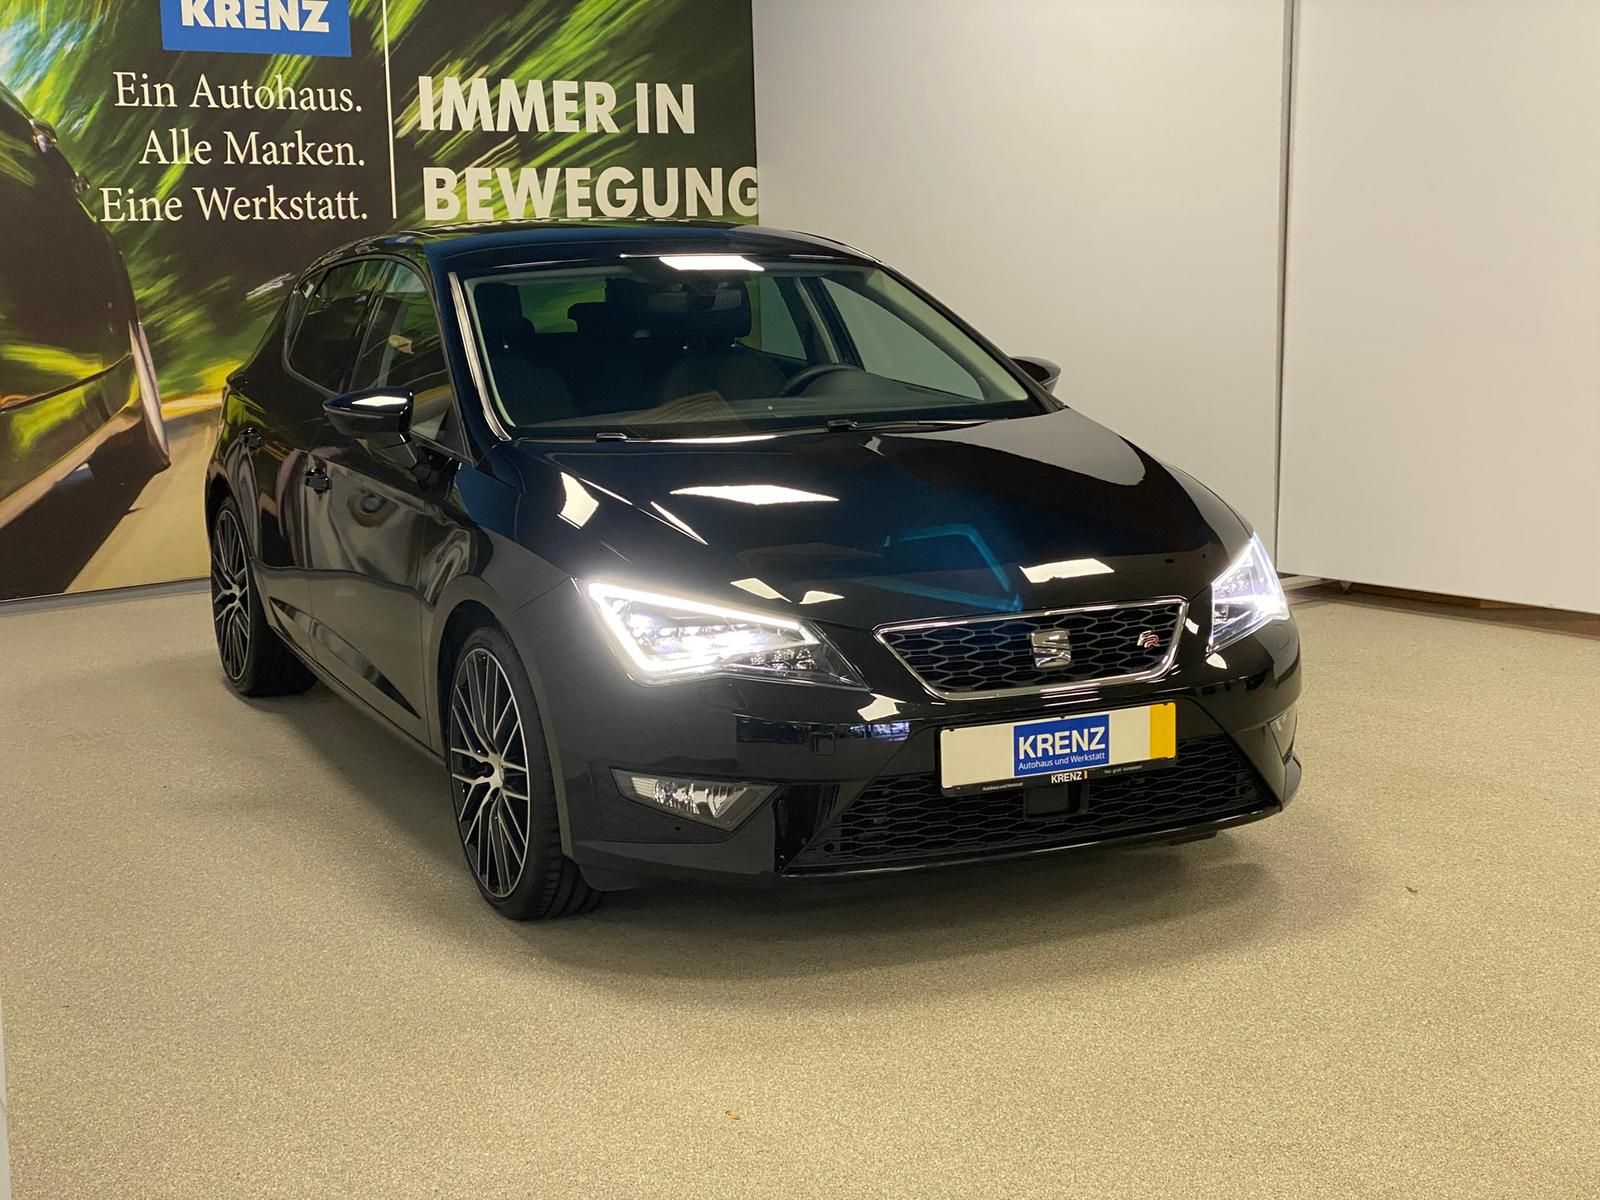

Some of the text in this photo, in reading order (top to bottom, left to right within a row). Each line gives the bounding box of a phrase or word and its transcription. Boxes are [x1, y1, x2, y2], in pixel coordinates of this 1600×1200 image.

[180, 0, 330, 33] KRENZ
[113, 71, 362, 112] Ein Autohaus.
[418, 76, 695, 135] IMMER IN
[138, 127, 365, 167] Alle Marken.
[99, 184, 368, 222] Eine Werkstatt.
[422, 166, 759, 221] BEWEGUNG
[1018, 726, 1105, 760] KRENZ
[1018, 752, 1105, 770] Autohaus und Werkstatt
[1051, 771, 1083, 784] KRENZ
